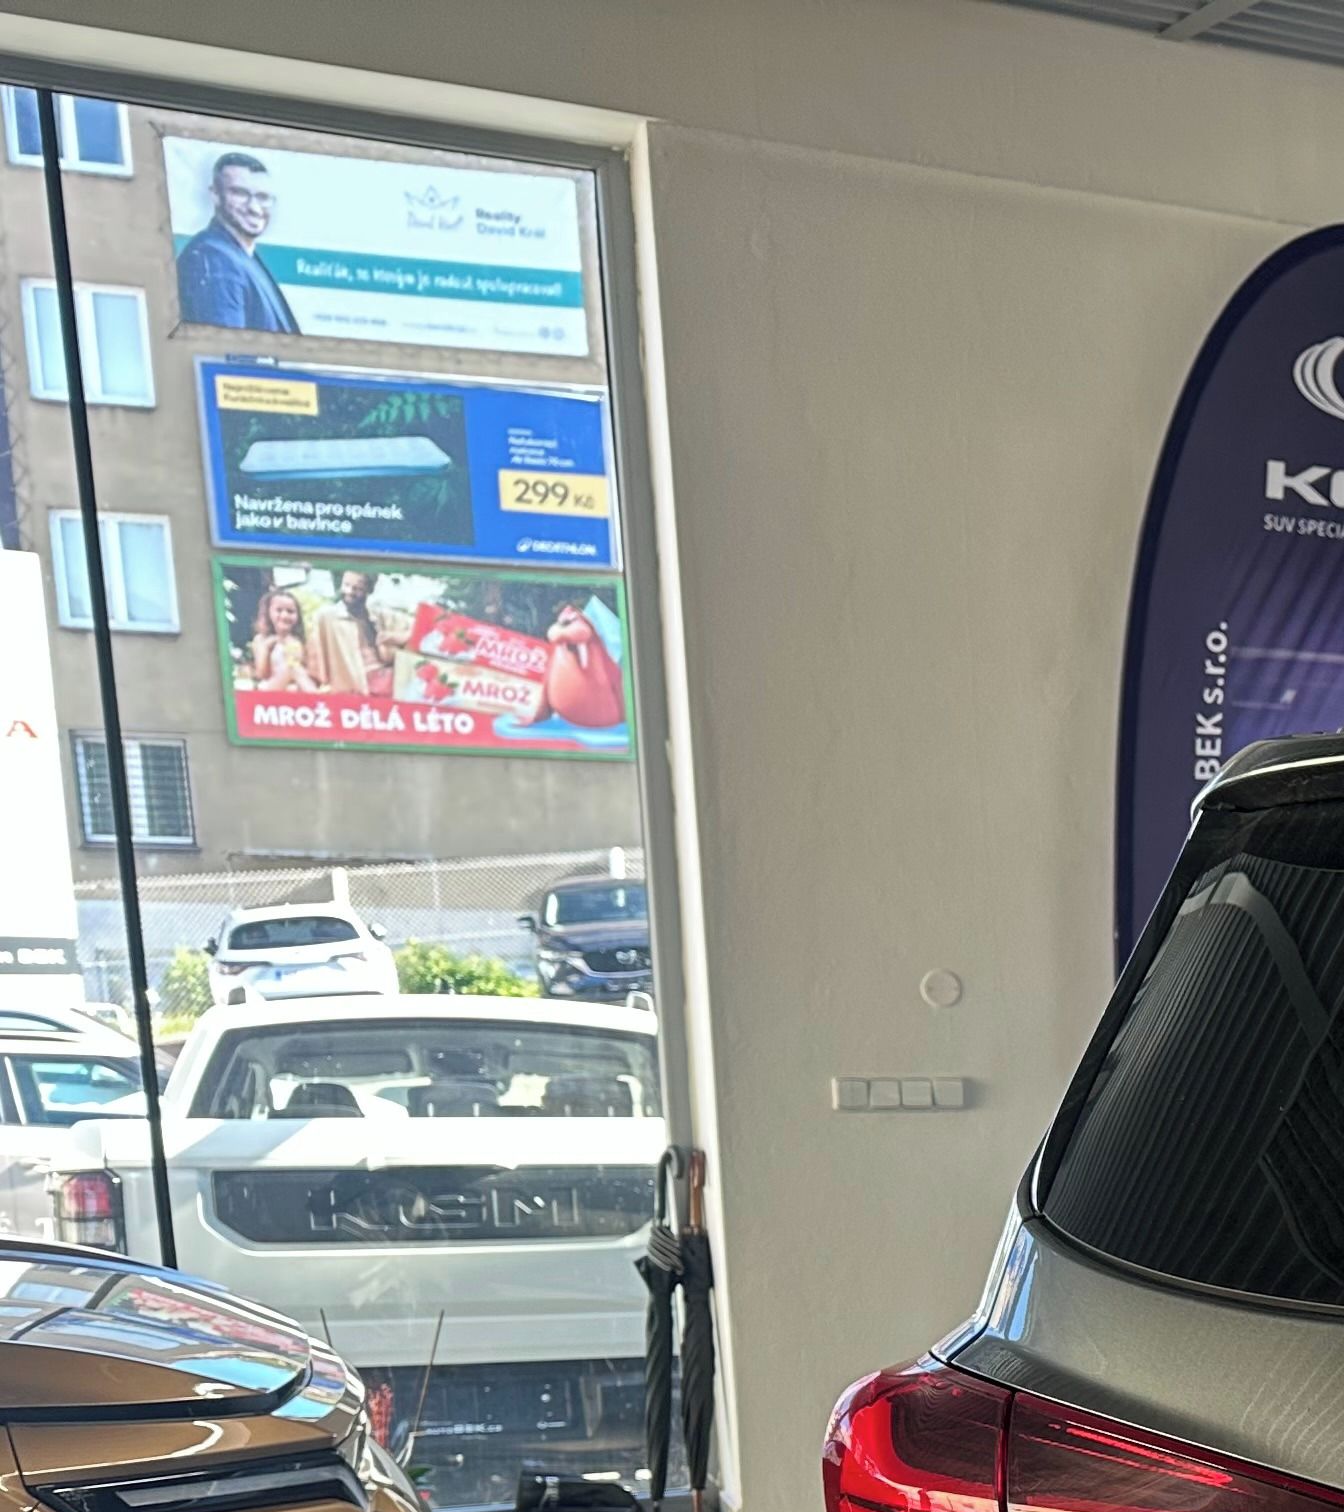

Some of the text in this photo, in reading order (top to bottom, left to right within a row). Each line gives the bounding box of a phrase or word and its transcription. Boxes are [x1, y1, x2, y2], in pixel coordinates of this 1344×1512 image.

[513, 479, 569, 507] 299
[234, 494, 403, 520] Navržena pro spánek
[235, 510, 272, 530] jako
[1263, 514, 1296, 533] SUV
[462, 679, 531, 703] MROŽ
[1194, 621, 1229, 781] BEK s.r.o.
[253, 701, 475, 733] MROŽ DĚLÁ LÉTO
